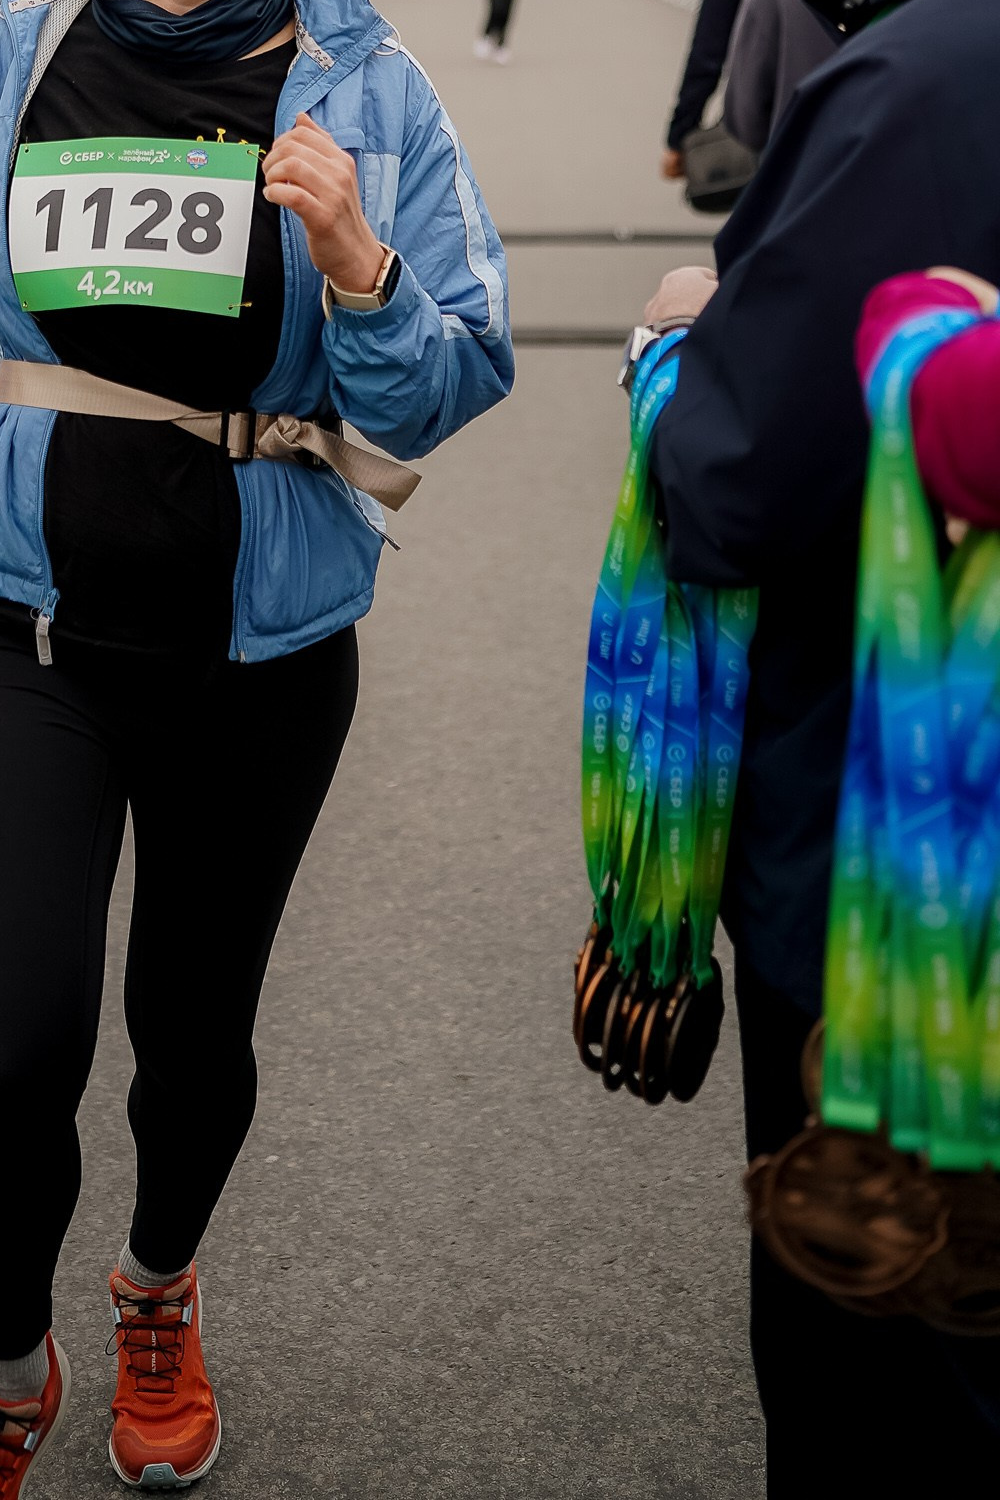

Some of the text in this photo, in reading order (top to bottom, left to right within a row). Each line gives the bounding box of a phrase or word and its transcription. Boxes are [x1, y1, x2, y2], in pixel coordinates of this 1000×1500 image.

[74, 151, 104, 162] СБЕР
[35, 187, 225, 255] 1128
[594, 713, 607, 754] СБЕР
[669, 766, 683, 808] СБЕР
[716, 767, 729, 809] СБЕР
